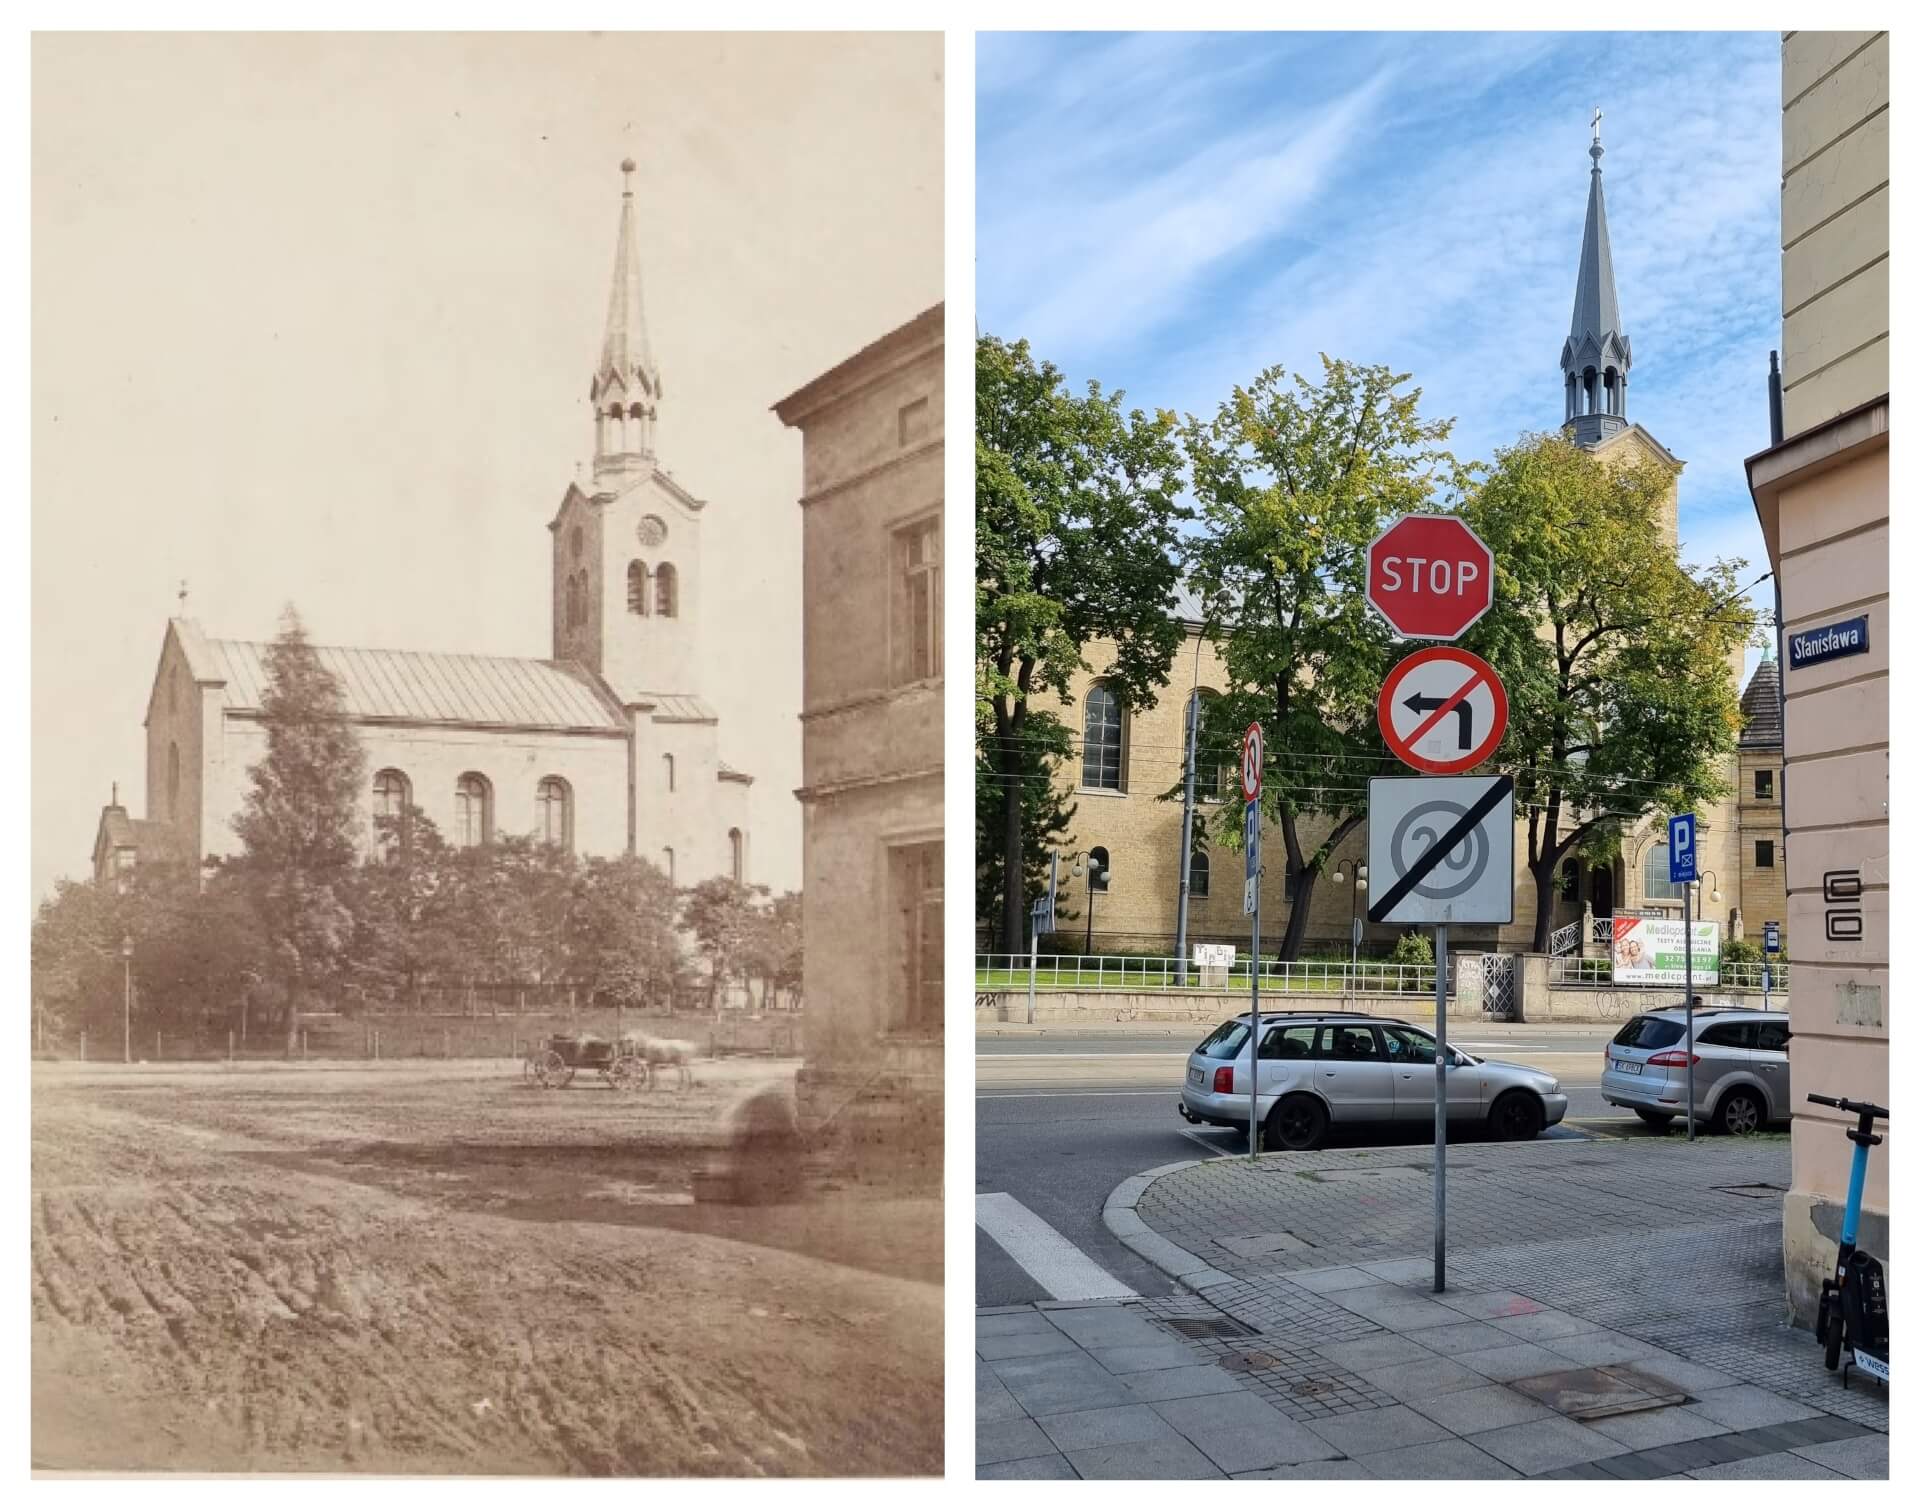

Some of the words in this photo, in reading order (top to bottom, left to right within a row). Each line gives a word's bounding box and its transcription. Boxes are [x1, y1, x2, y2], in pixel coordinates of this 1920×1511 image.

[1382, 556, 1478, 596] STOP
[1794, 628, 1859, 660] Stanisława
[1674, 821, 1690, 863] P
[1646, 924, 1698, 936] Medicpont
